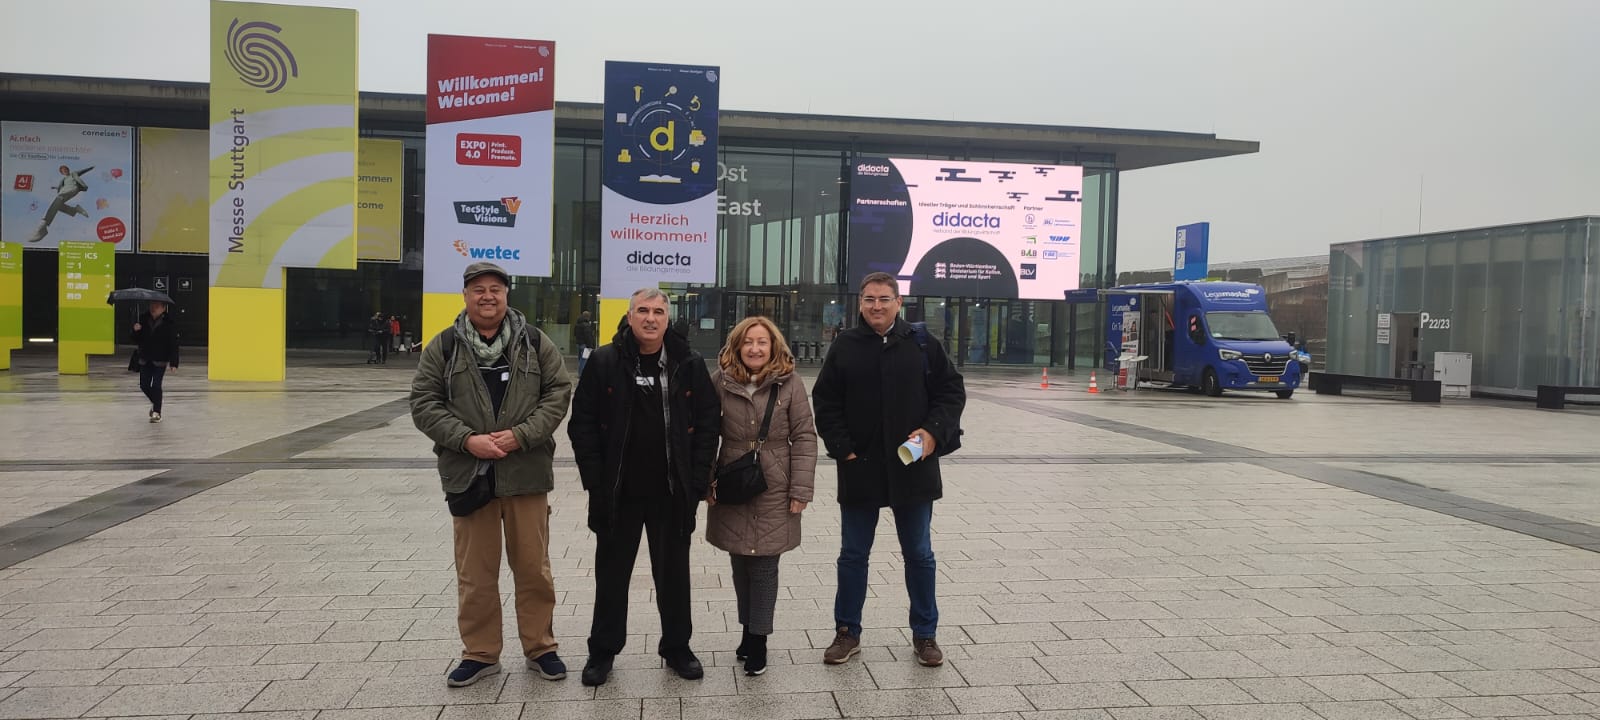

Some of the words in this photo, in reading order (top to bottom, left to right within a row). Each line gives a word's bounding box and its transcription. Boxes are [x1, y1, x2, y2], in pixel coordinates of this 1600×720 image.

[438, 67, 544, 93] Willkommen!
[438, 87, 515, 109] Welcome!
[82, 129, 121, 137] cornelsen
[228, 108, 250, 191] Stuttgart
[460, 140, 486, 149] EXPO
[465, 150, 481, 159] 4.0
[857, 164, 890, 173] didacta
[358, 175, 393, 183] ommen
[357, 201, 384, 209] come
[717, 195, 762, 217] East
[856, 198, 908, 207] Partnerschaften
[460, 204, 500, 215] TecStyle
[228, 196, 244, 253] Messe
[474, 214, 508, 223] Visions
[630, 213, 689, 226] Herzlich
[932, 211, 1001, 229] didacta
[610, 227, 708, 243] willkommen!
[84, 252, 98, 260] ICS
[469, 245, 520, 260] wetec
[626, 250, 692, 266] didacta
[1420, 311, 1430, 329] P
[1429, 318, 1450, 329] 22/23
